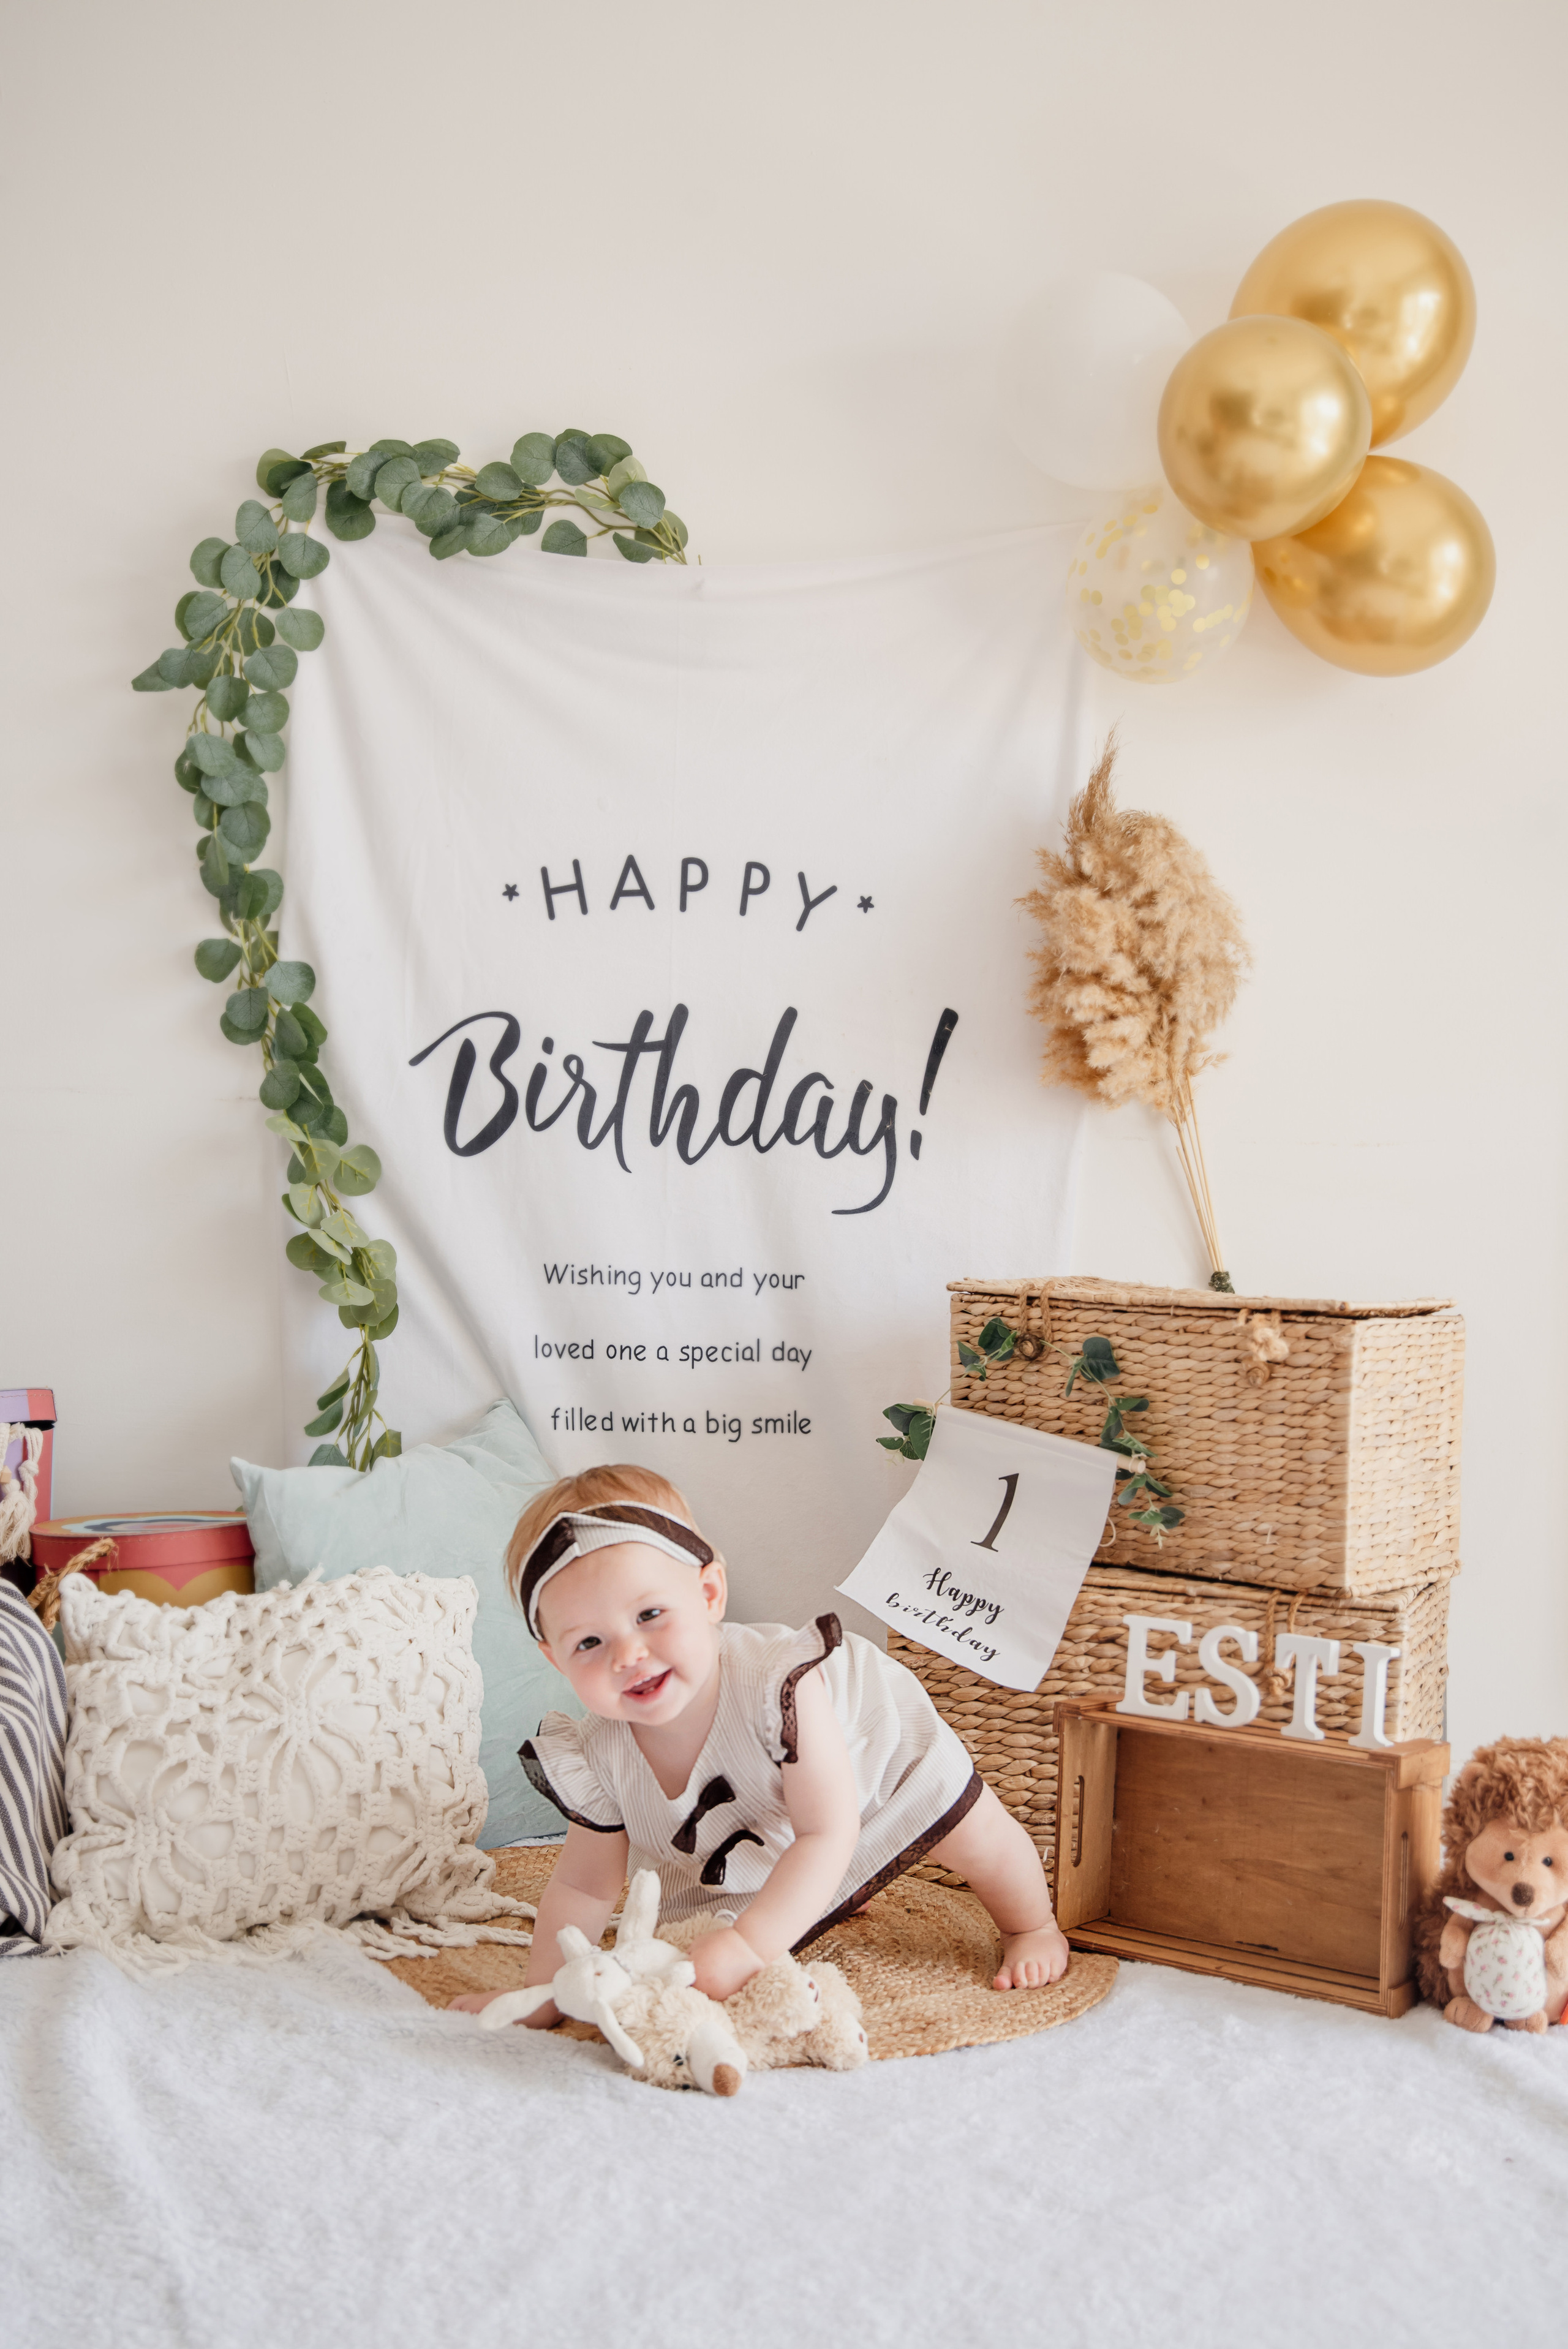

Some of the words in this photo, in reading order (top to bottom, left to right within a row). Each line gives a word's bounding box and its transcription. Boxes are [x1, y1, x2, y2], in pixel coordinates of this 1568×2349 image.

[540, 854, 839, 932] HAPPY
[408, 1002, 960, 1216] Birthday!
[543, 1262, 641, 1295] Wishing
[649, 1271, 692, 1295] you
[700, 1266, 744, 1289] and
[753, 1272, 805, 1297] your
[534, 1333, 595, 1360] loved
[605, 1343, 647, 1362] one
[656, 1344, 670, 1362] a
[678, 1338, 761, 1370] special
[771, 1340, 813, 1373] day
[550, 1406, 614, 1432] filled
[621, 1411, 677, 1434] with
[682, 1417, 697, 1435] a
[705, 1409, 742, 1444] big
[750, 1409, 812, 1436] smile
[970, 1472, 1020, 1553] 1
[884, 1591, 1001, 1662] birthday
[922, 1566, 1005, 1626] Happy
[1115, 1613, 1402, 1749] ESTI
